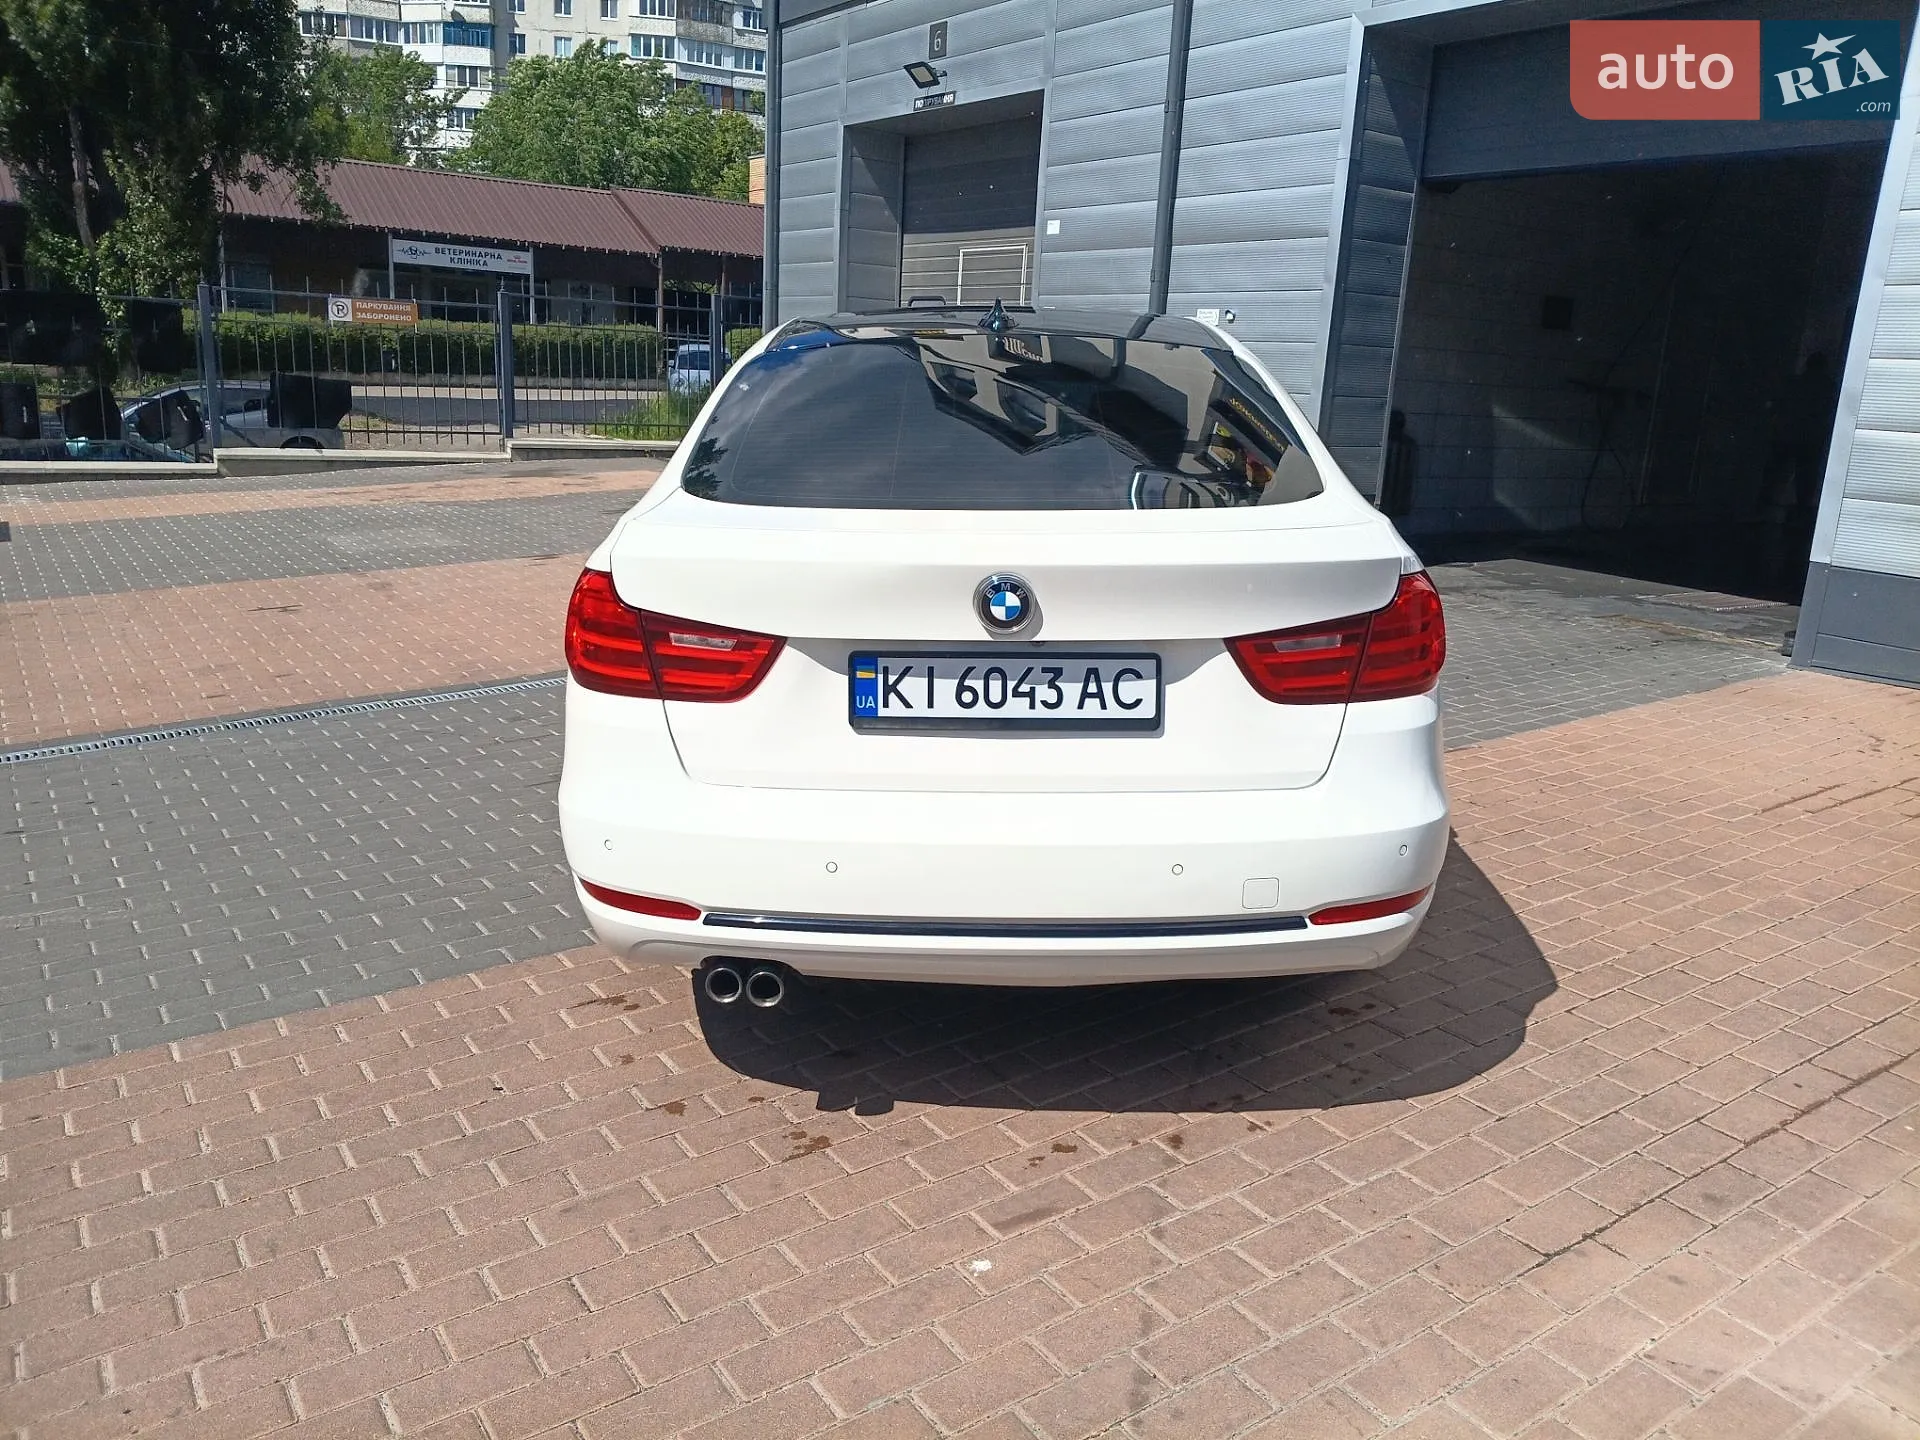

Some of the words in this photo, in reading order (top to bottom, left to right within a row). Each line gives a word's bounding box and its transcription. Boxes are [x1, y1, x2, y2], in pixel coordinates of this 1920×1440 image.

[934, 30, 941, 51] 6
[434, 247, 502, 261] ВЕТЕРИНАРНА
[449, 256, 488, 267] КЛІНІКА
[356, 301, 411, 312] ПАРКУВАННЯ
[356, 312, 411, 321] ЗАБОРОНЕНО
[985, 582, 1026, 599] BMW
[881, 665, 935, 709] KI
[955, 665, 1063, 710] 6043
[1077, 667, 1144, 711] AC
[856, 695, 876, 709] UA
